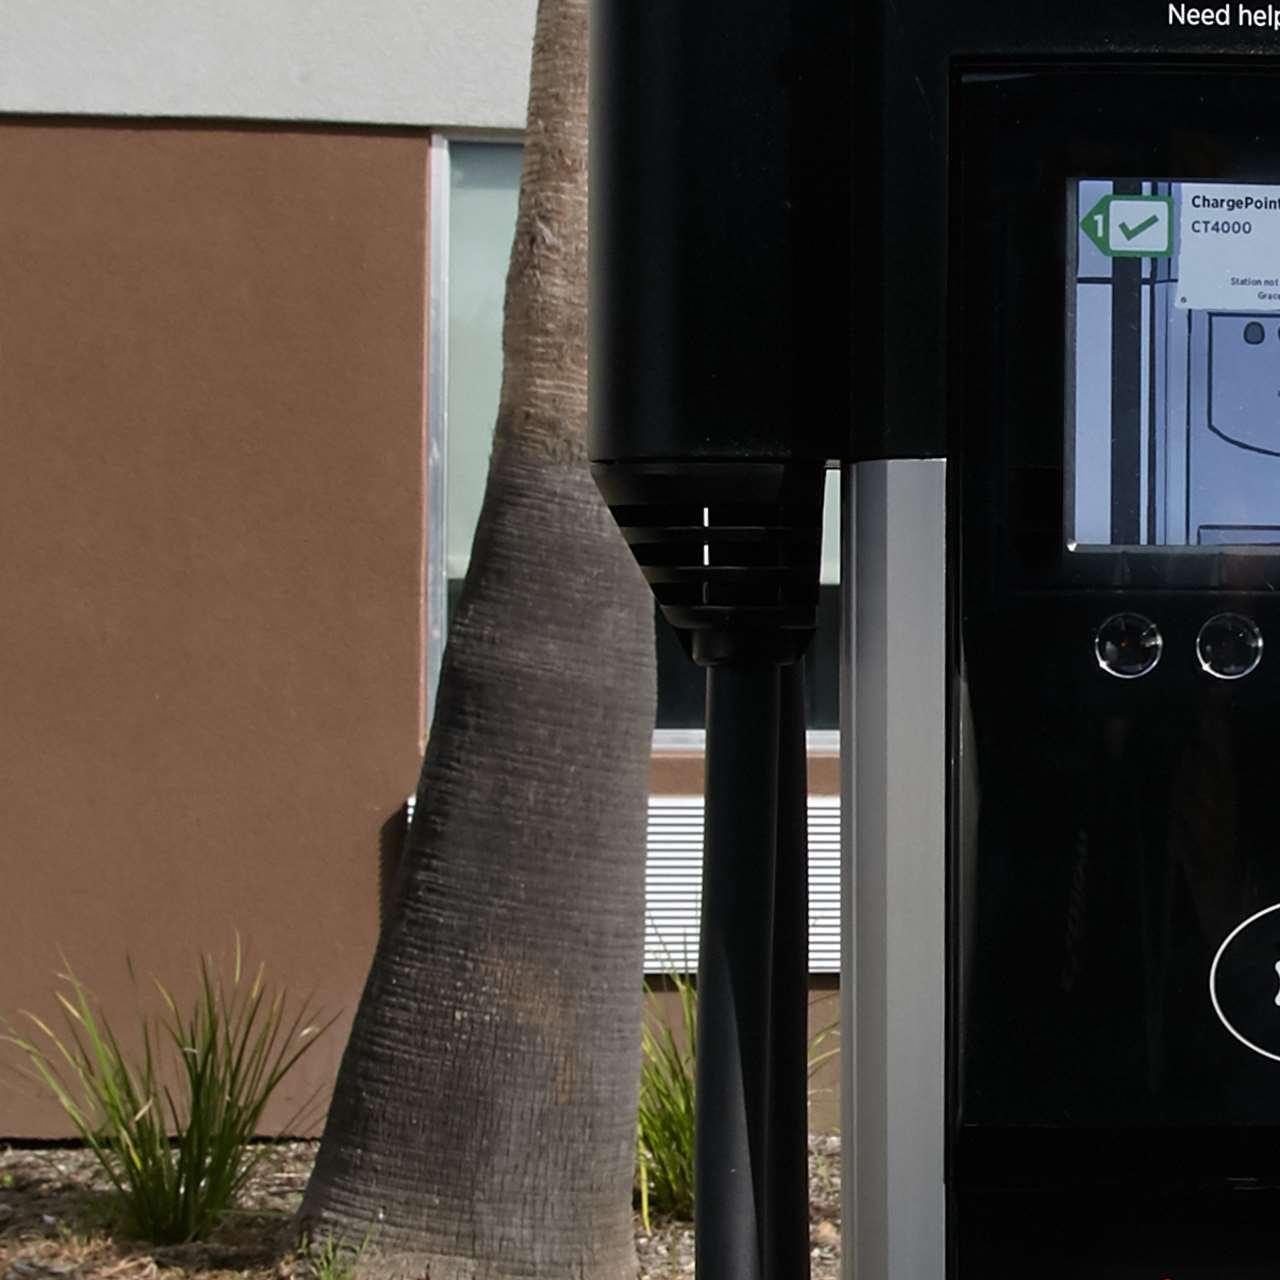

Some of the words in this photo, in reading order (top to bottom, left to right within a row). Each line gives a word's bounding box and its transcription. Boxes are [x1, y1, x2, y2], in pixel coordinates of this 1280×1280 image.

[1168, 3, 1230, 26] Need
[1093, 213, 1104, 237] 1
[1191, 220, 1252, 234] CT4000
[1230, 277, 1262, 287] Station
[1263, 278, 1279, 287] not
